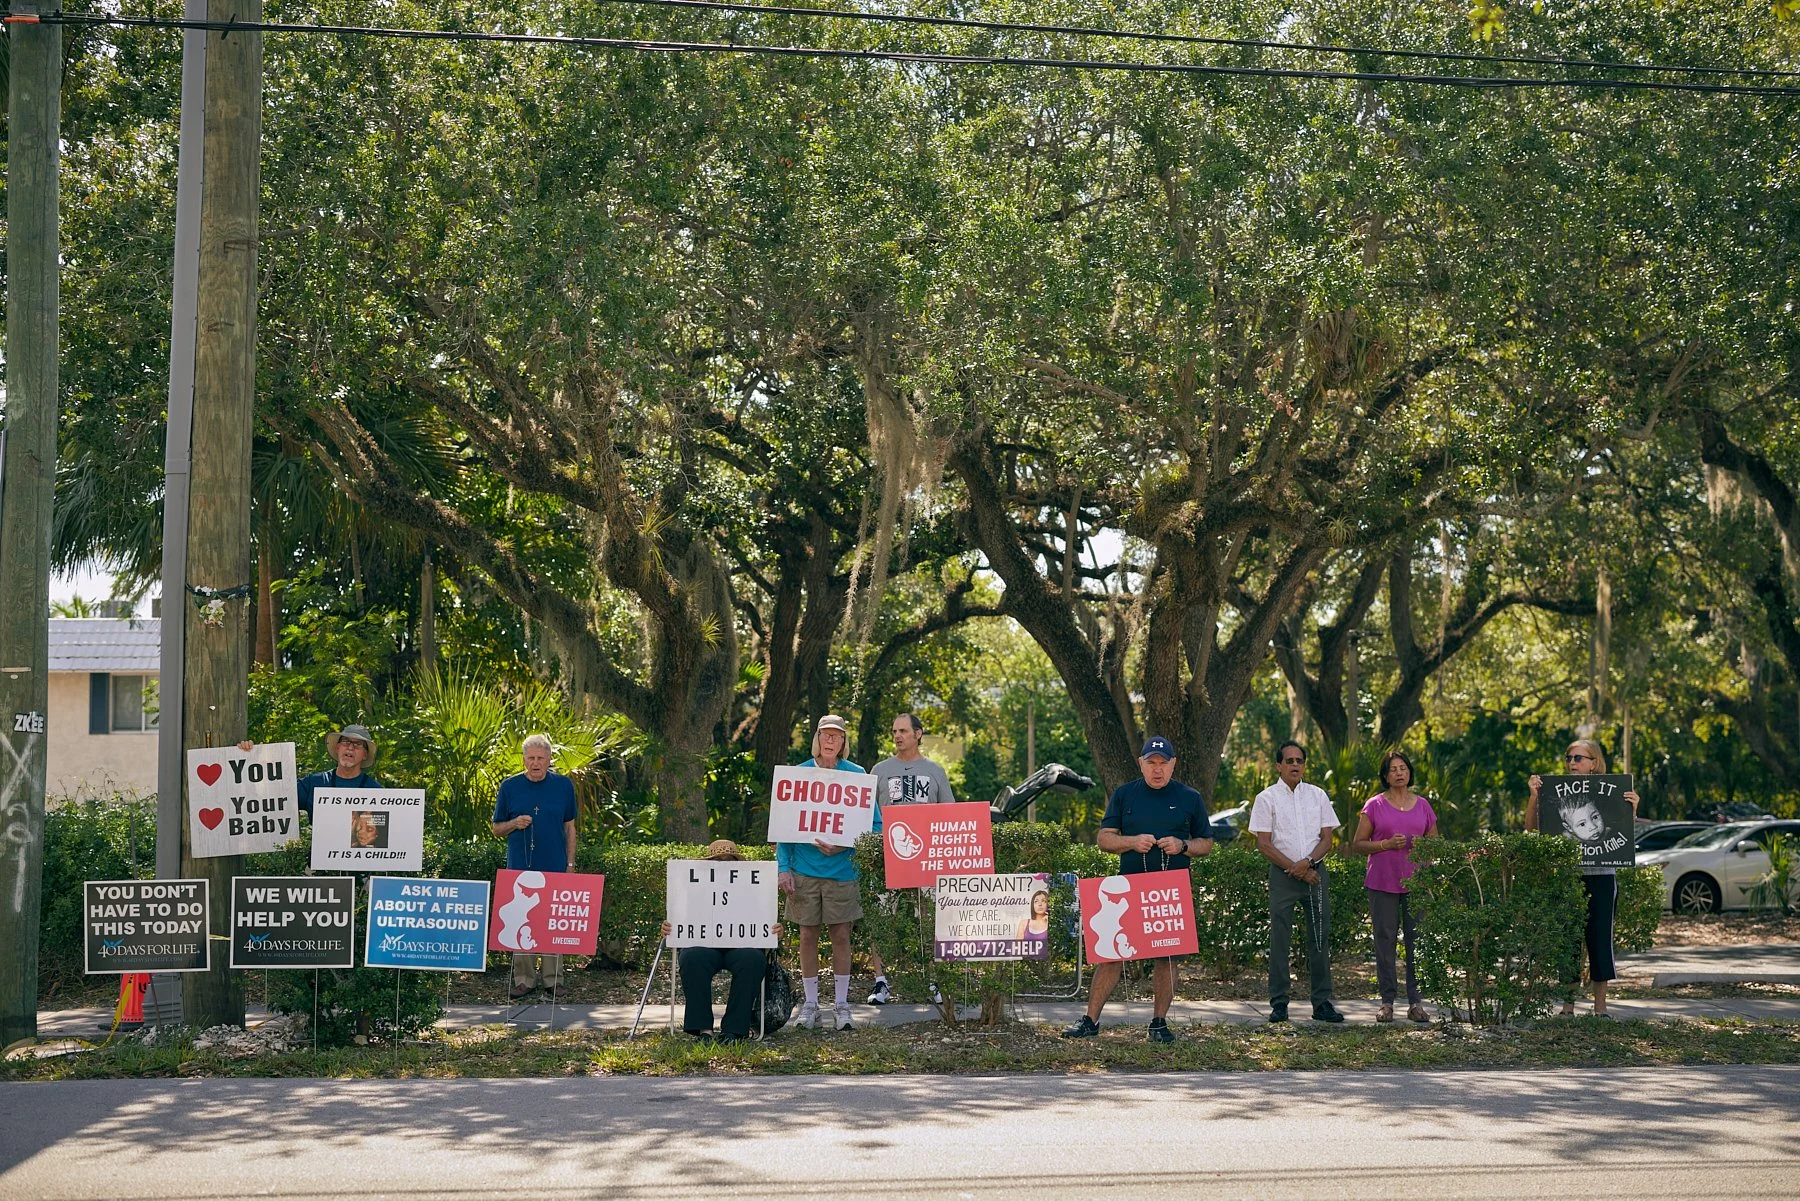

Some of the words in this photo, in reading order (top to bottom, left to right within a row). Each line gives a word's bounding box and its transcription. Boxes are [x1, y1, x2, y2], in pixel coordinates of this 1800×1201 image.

[228, 759, 283, 784] You
[776, 779, 872, 809] CHOOSE
[1555, 780, 1590, 798] FACE
[1598, 781, 1617, 796] IT
[230, 796, 288, 815] Your
[318, 796, 329, 805] IT
[331, 797, 342, 805] IS
[344, 797, 367, 805] NOT
[369, 797, 377, 805] A
[380, 798, 420, 806] CHOICE
[228, 815, 291, 836] Baby
[798, 810, 845, 835] LIFE
[930, 820, 977, 833] HUMAN
[931, 833, 977, 845] RIGHTS
[1603, 831, 1628, 853] Kills!
[327, 850, 339, 859] IT
[341, 851, 352, 859] IS
[354, 851, 362, 859] A
[364, 851, 407, 859] CHILD!!!
[928, 846, 967, 858] BEGIN
[968, 845, 982, 856] IN
[920, 860, 943, 871] THE
[948, 858, 991, 870] WOMB
[689, 868, 760, 884] LIFE
[95, 886, 135, 900] YOU
[141, 885, 197, 899] DON'T
[401, 884, 433, 897] ASK
[436, 886, 459, 898] ME
[938, 876, 1033, 893] PREGNANT?
[245, 888, 280, 903] WE
[286, 888, 341, 903] WILL
[552, 889, 591, 903] LOVE
[712, 891, 728, 906] IS
[937, 895, 960, 911] You
[962, 896, 988, 907] have
[990, 895, 1030, 908] options.
[1140, 888, 1180, 904] LOVE
[90, 904, 140, 918] HAVE
[145, 903, 171, 917] TO
[177, 902, 203, 916] DO
[373, 899, 426, 913] ABOUT
[430, 902, 441, 913] A
[445, 903, 484, 915] FREE
[550, 904, 590, 918] THEM
[1141, 903, 1183, 919] THEM
[237, 911, 295, 927] HELP
[302, 911, 349, 927] YOU
[376, 916, 479, 931] ULTRASOUND
[959, 910, 974, 921] WE
[975, 910, 1001, 921] CARE.
[91, 922, 136, 936] THIS
[141, 920, 202, 935] TODAY
[548, 918, 588, 932] BOTH
[677, 923, 769, 939] PRECIOUS
[948, 925, 963, 936] WE
[965, 925, 984, 936] CAN
[986, 924, 1011, 936] HELP!
[1143, 918, 1185, 934] BOTH
[940, 941, 1043, 957] 1-800-712-HELP
